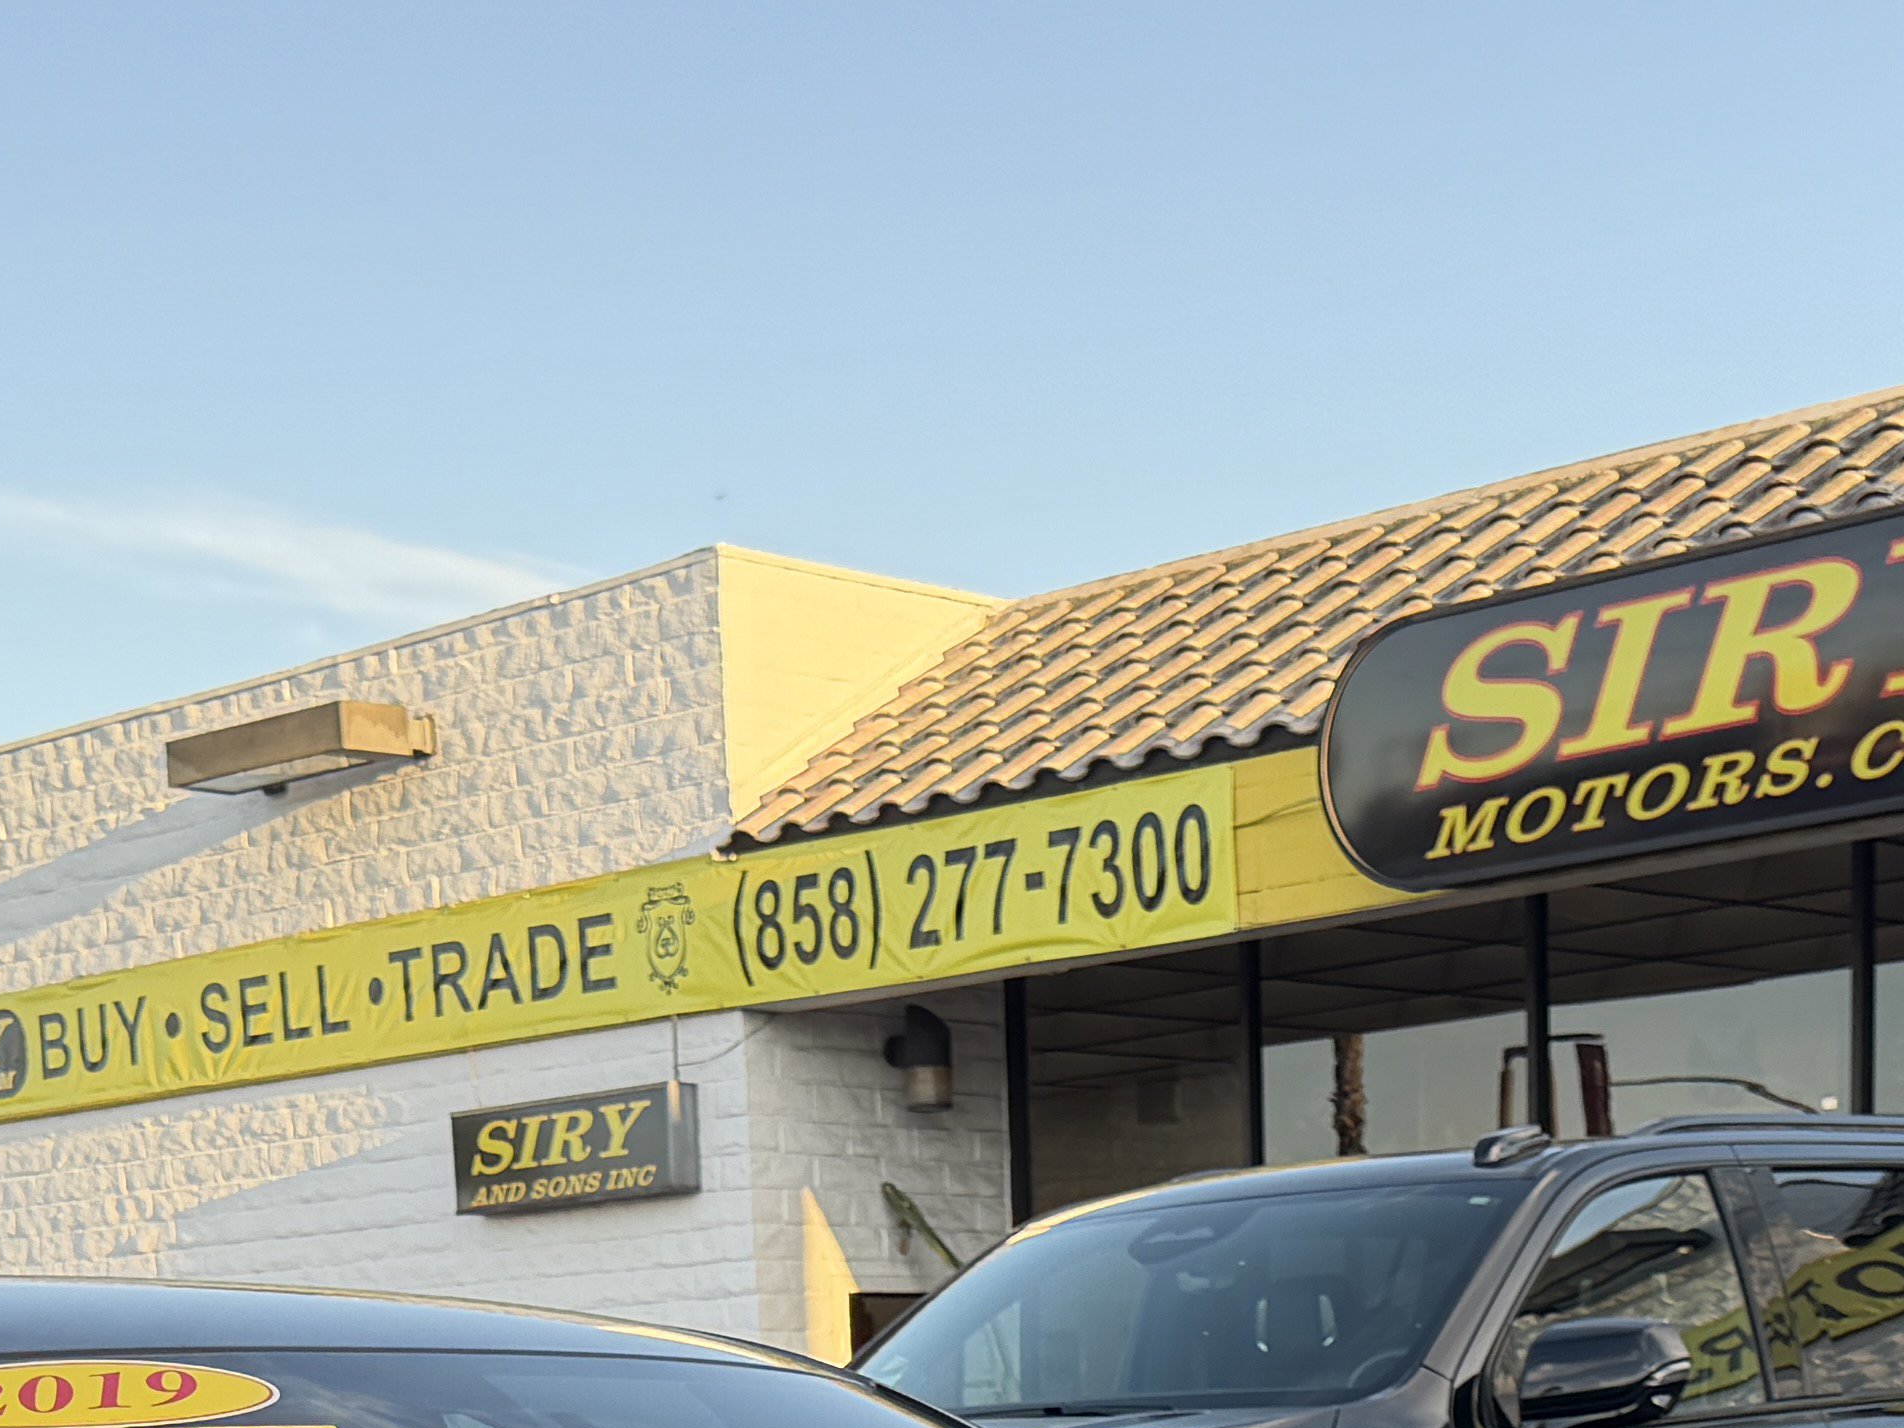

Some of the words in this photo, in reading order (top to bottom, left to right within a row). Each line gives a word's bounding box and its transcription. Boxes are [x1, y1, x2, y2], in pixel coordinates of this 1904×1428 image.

[733, 850, 884, 987] (858)
[906, 803, 1212, 950] 277-7300
[38, 997, 148, 1080] BUY
[200, 964, 350, 1055] SELL
[387, 913, 618, 1022] TRADE
[470, 1099, 652, 1177] SIRY
[470, 1180, 527, 1208] AND
[532, 1171, 602, 1201] SONS
[604, 1164, 658, 1191] INC
